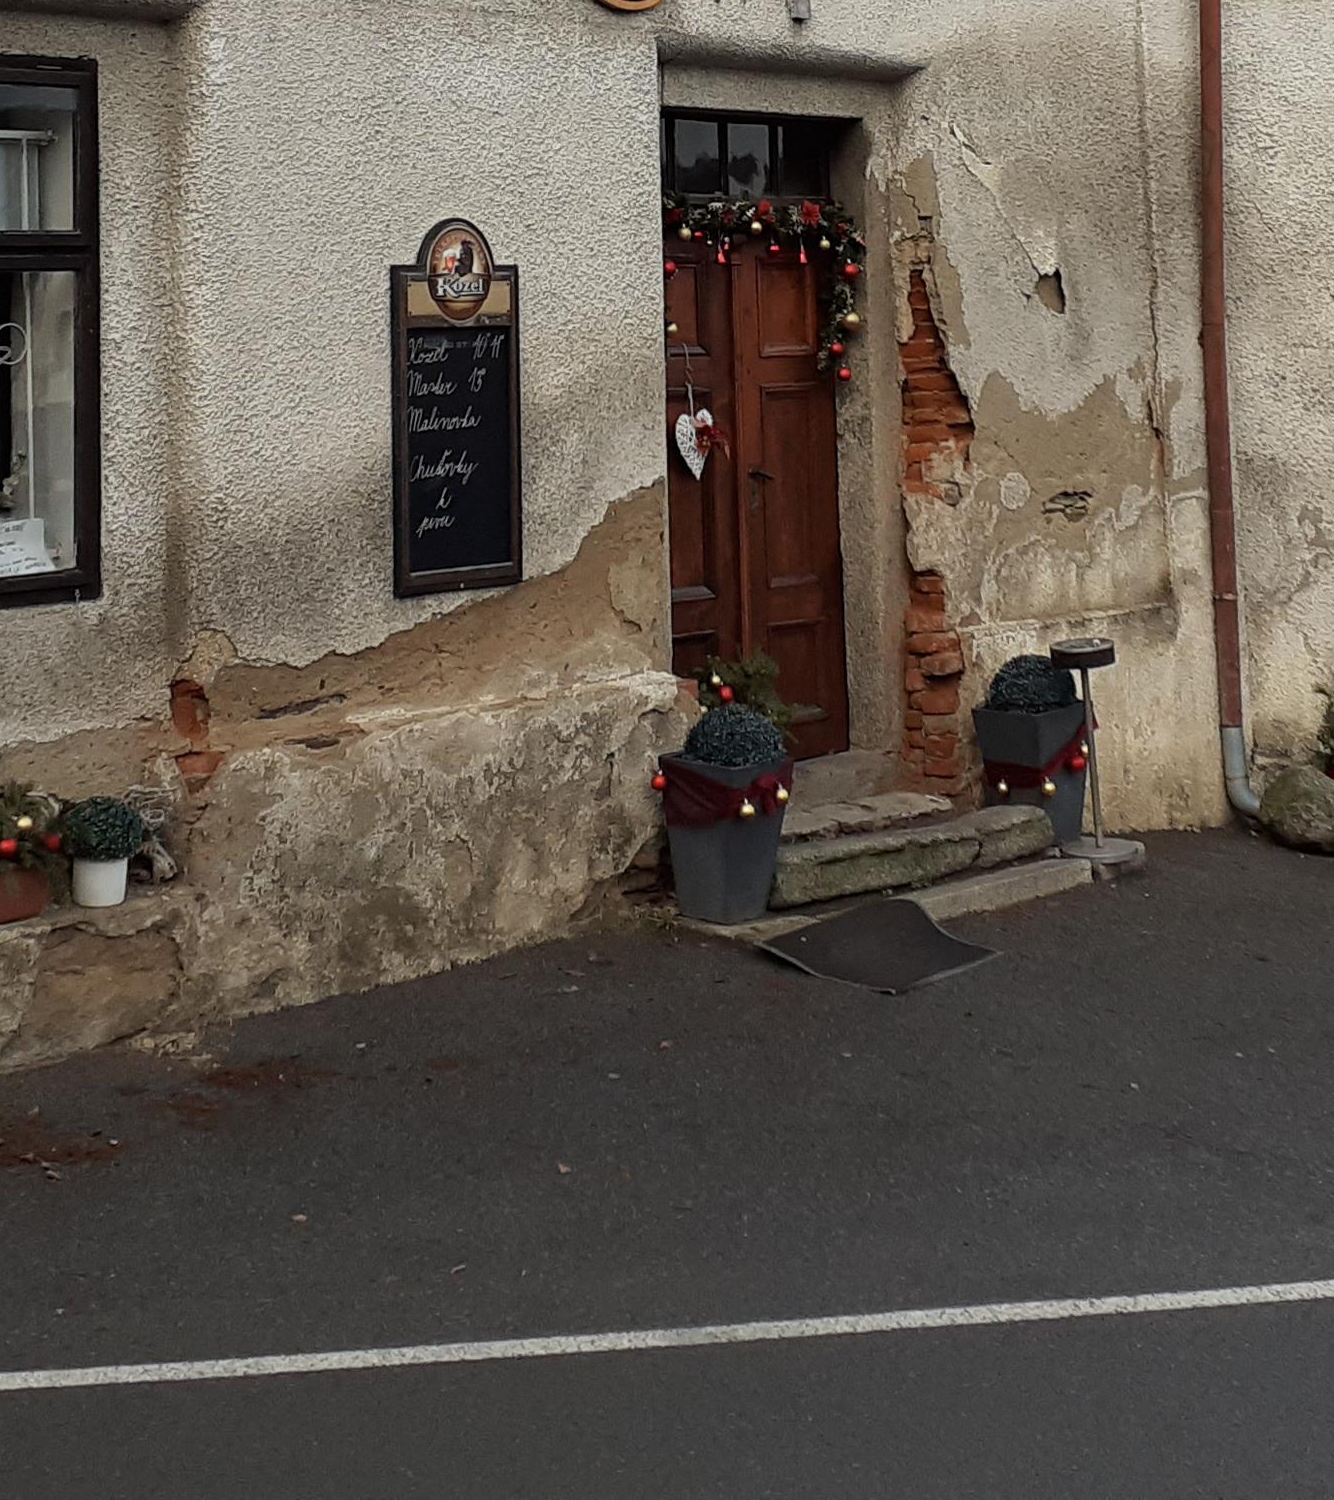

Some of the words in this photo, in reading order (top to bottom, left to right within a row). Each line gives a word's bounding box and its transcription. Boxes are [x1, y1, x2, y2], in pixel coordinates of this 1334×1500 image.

[436, 277, 484, 298] Kozel
[407, 337, 449, 365] Kozel
[407, 369, 458, 396] Master
[407, 405, 481, 432] Malinovka
